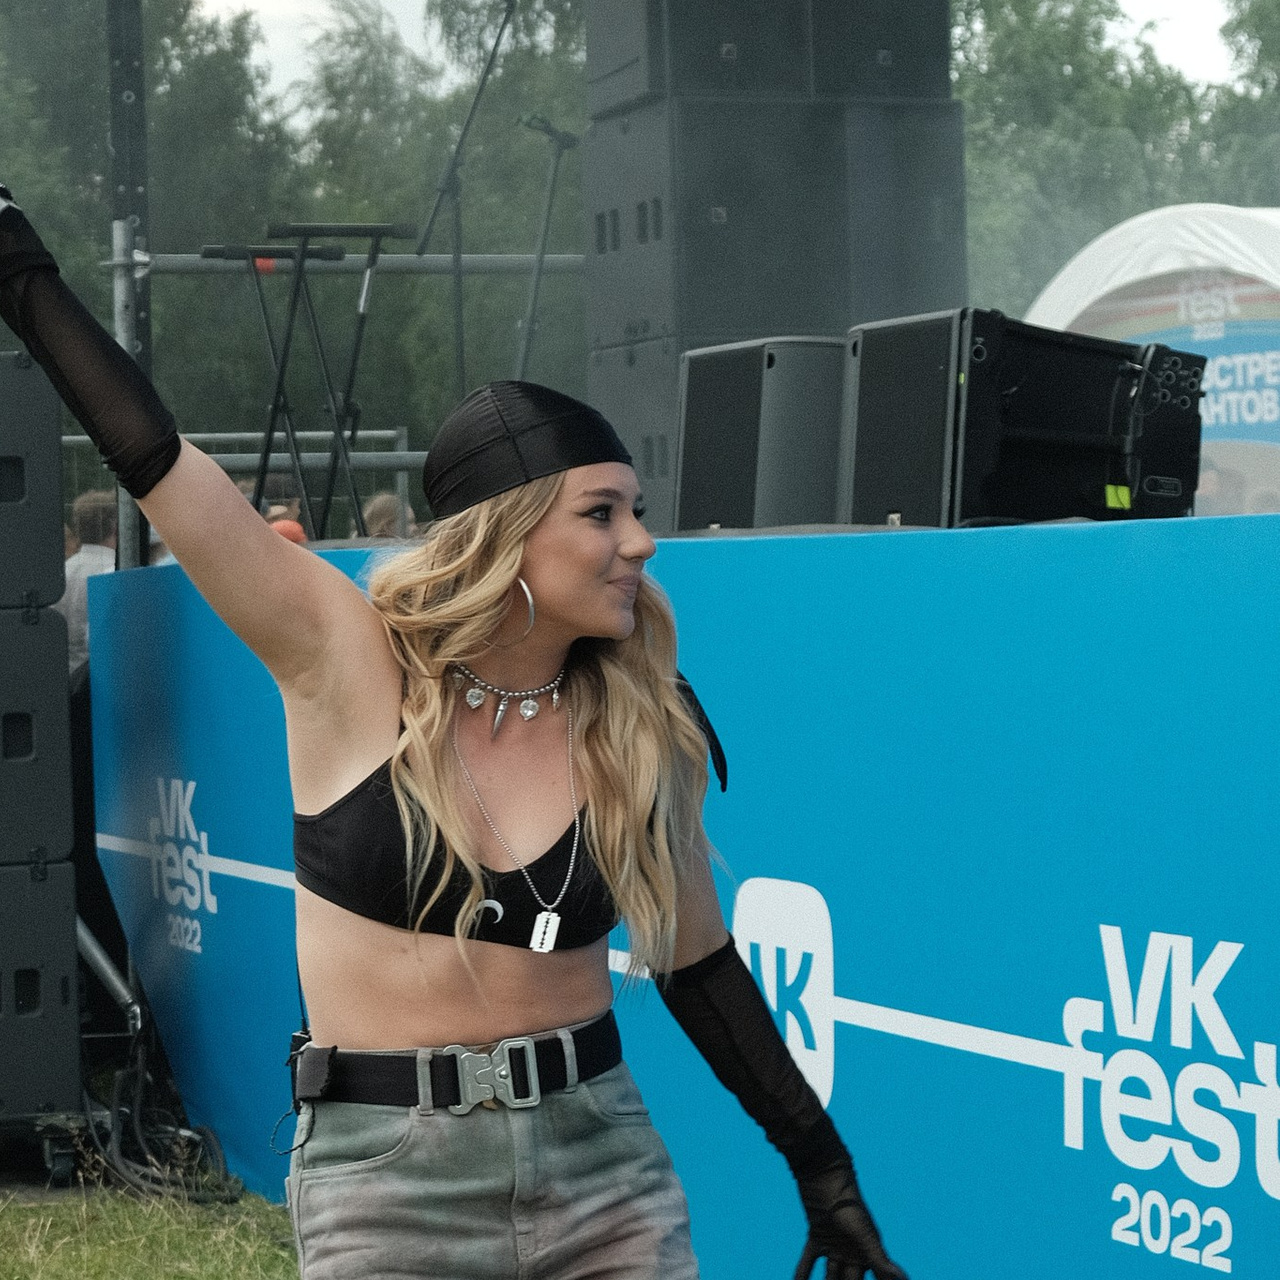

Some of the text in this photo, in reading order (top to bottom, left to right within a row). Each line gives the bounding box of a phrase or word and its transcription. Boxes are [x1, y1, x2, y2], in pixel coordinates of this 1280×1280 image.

[157, 777, 199, 842] VK
[149, 817, 218, 914] fest
[170, 914, 202, 953] 2022
[1099, 923, 1245, 1059] VK
[1062, 996, 1280, 1201] fest
[1111, 1182, 1233, 1273] 2022
